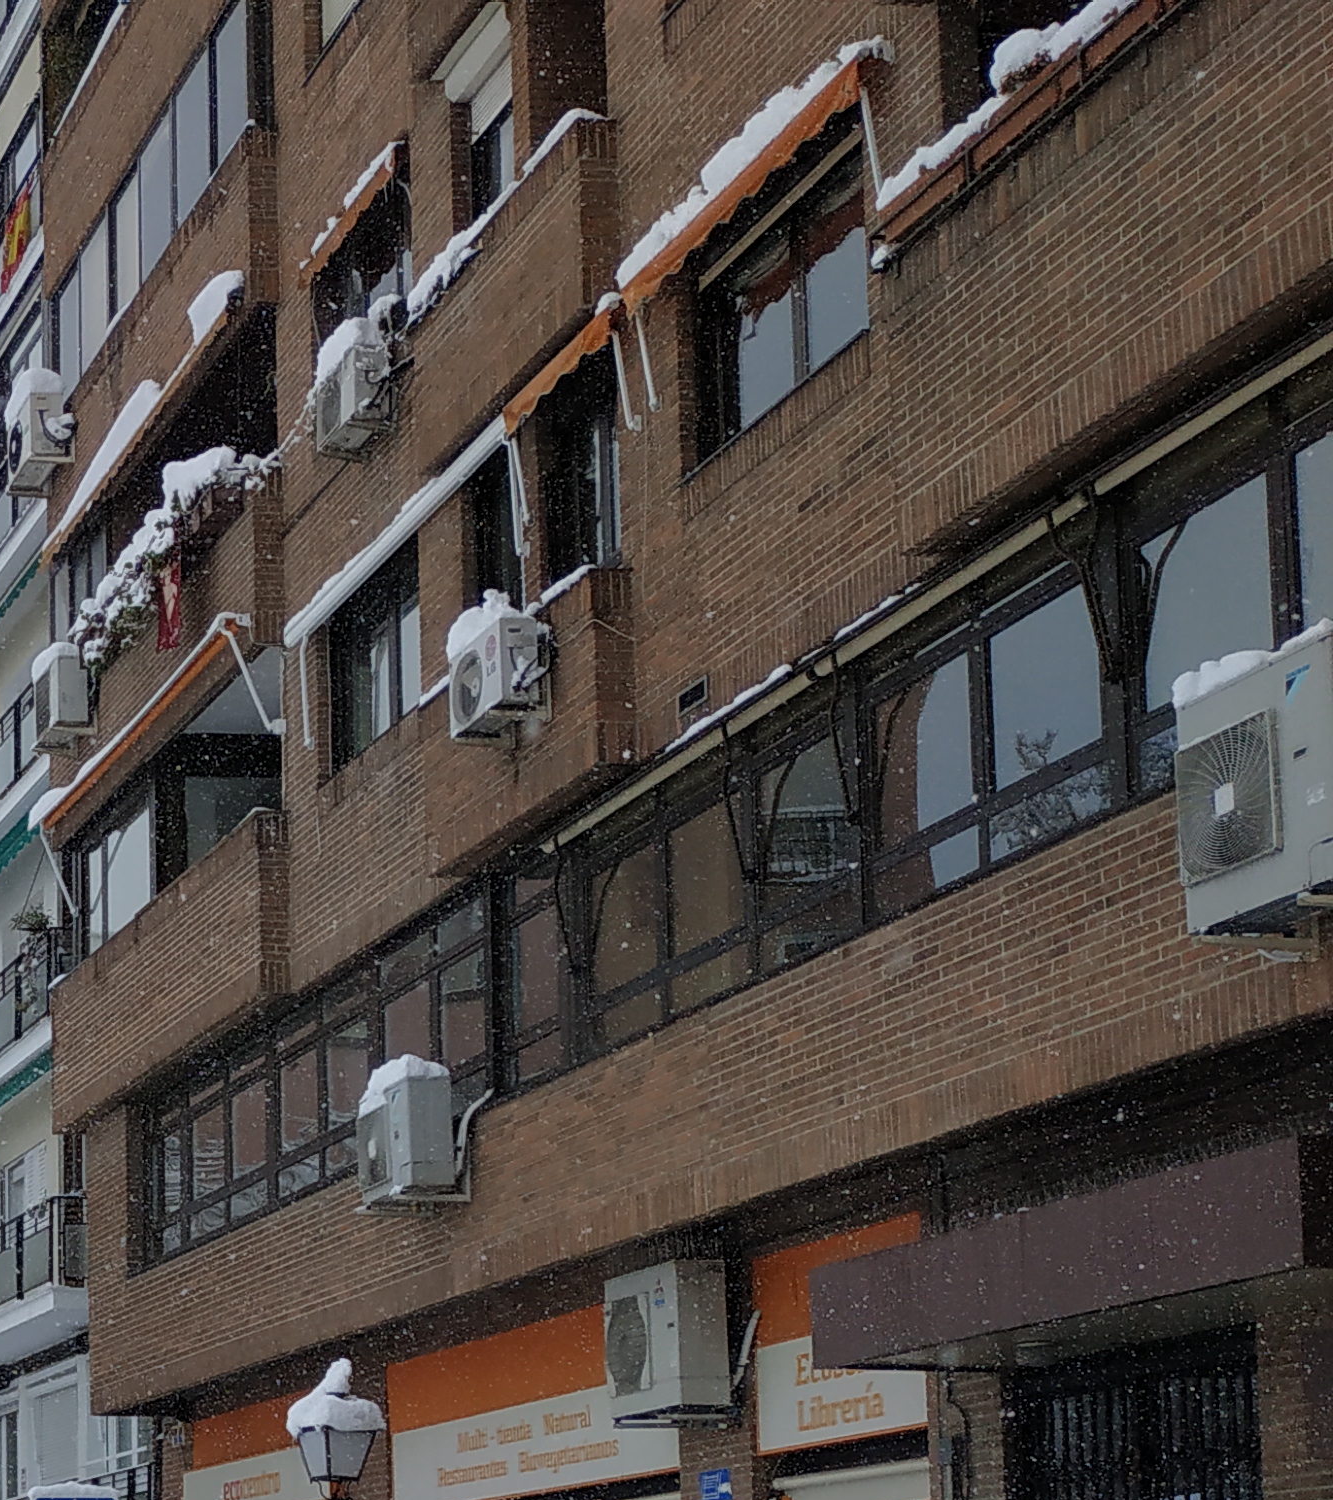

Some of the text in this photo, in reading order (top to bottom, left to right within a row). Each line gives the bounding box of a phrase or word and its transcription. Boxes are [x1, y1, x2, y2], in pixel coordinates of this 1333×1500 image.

[543, 1404, 592, 1435] Natural
[797, 1380, 885, 1432] Librería
[437, 1459, 509, 1487] Restaurantes
